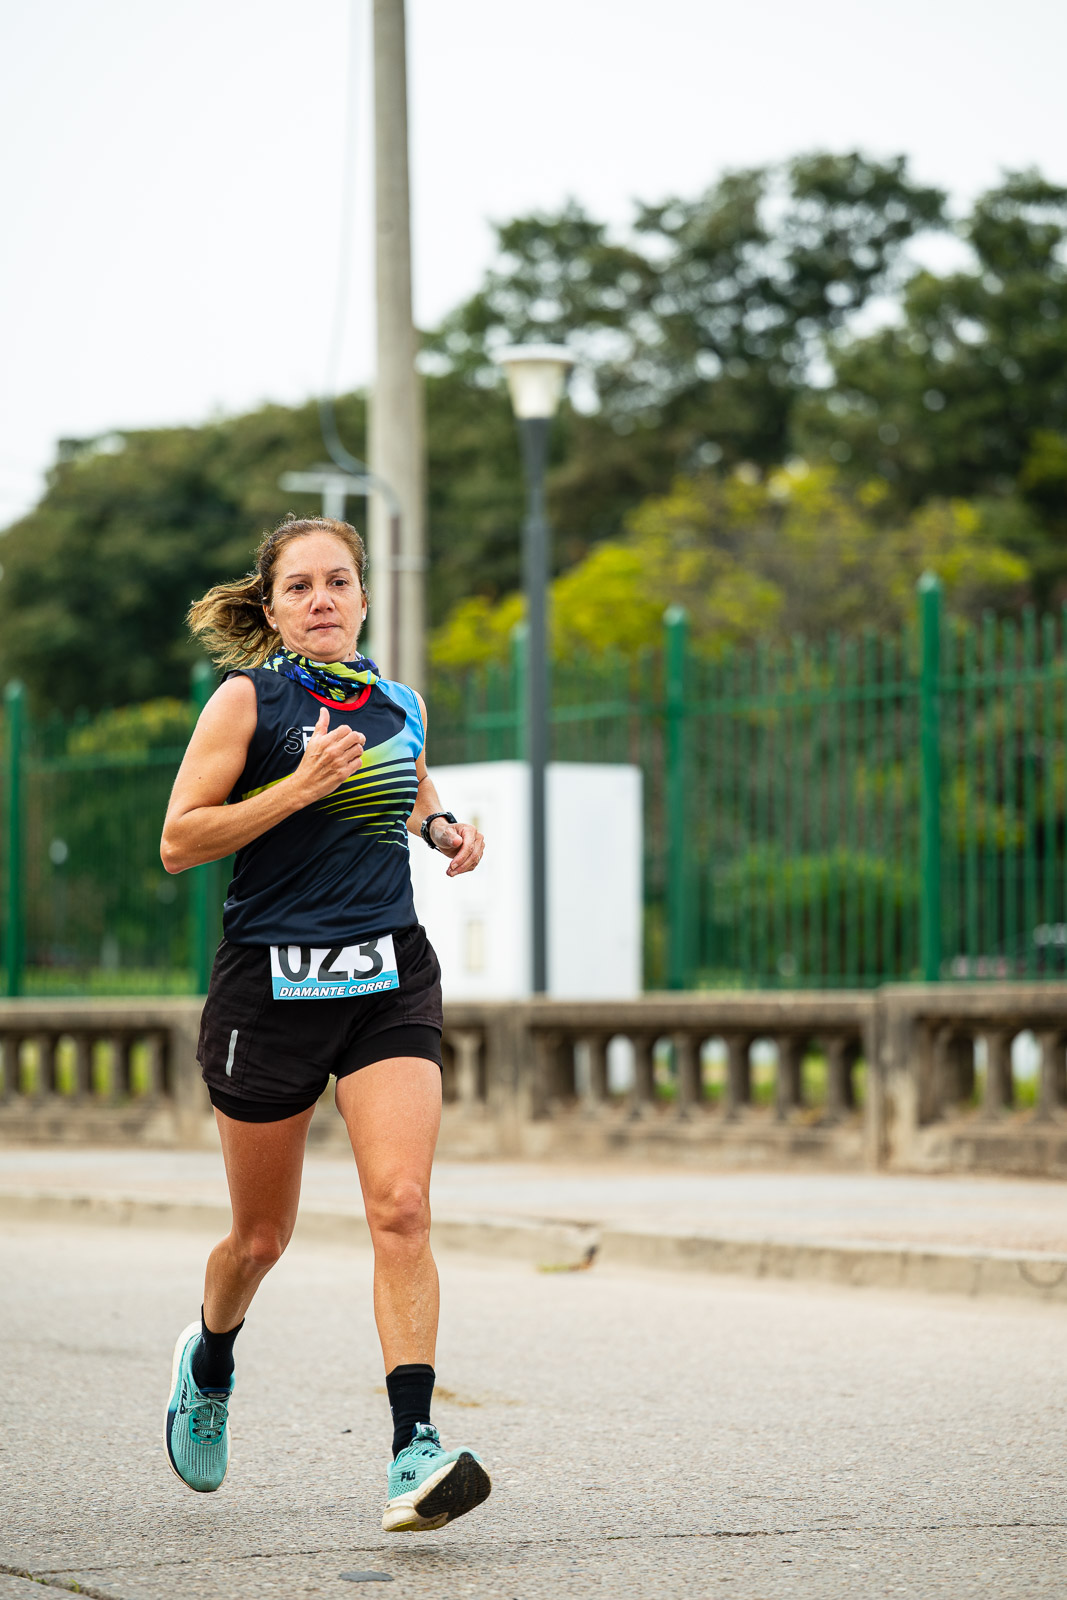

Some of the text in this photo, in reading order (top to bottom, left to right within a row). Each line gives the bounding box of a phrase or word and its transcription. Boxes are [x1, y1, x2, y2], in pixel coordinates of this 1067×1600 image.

[278, 939, 383, 982] 023
[279, 980, 392, 997] DIAMANTE CORRE
[401, 1470, 416, 1482] FILA
